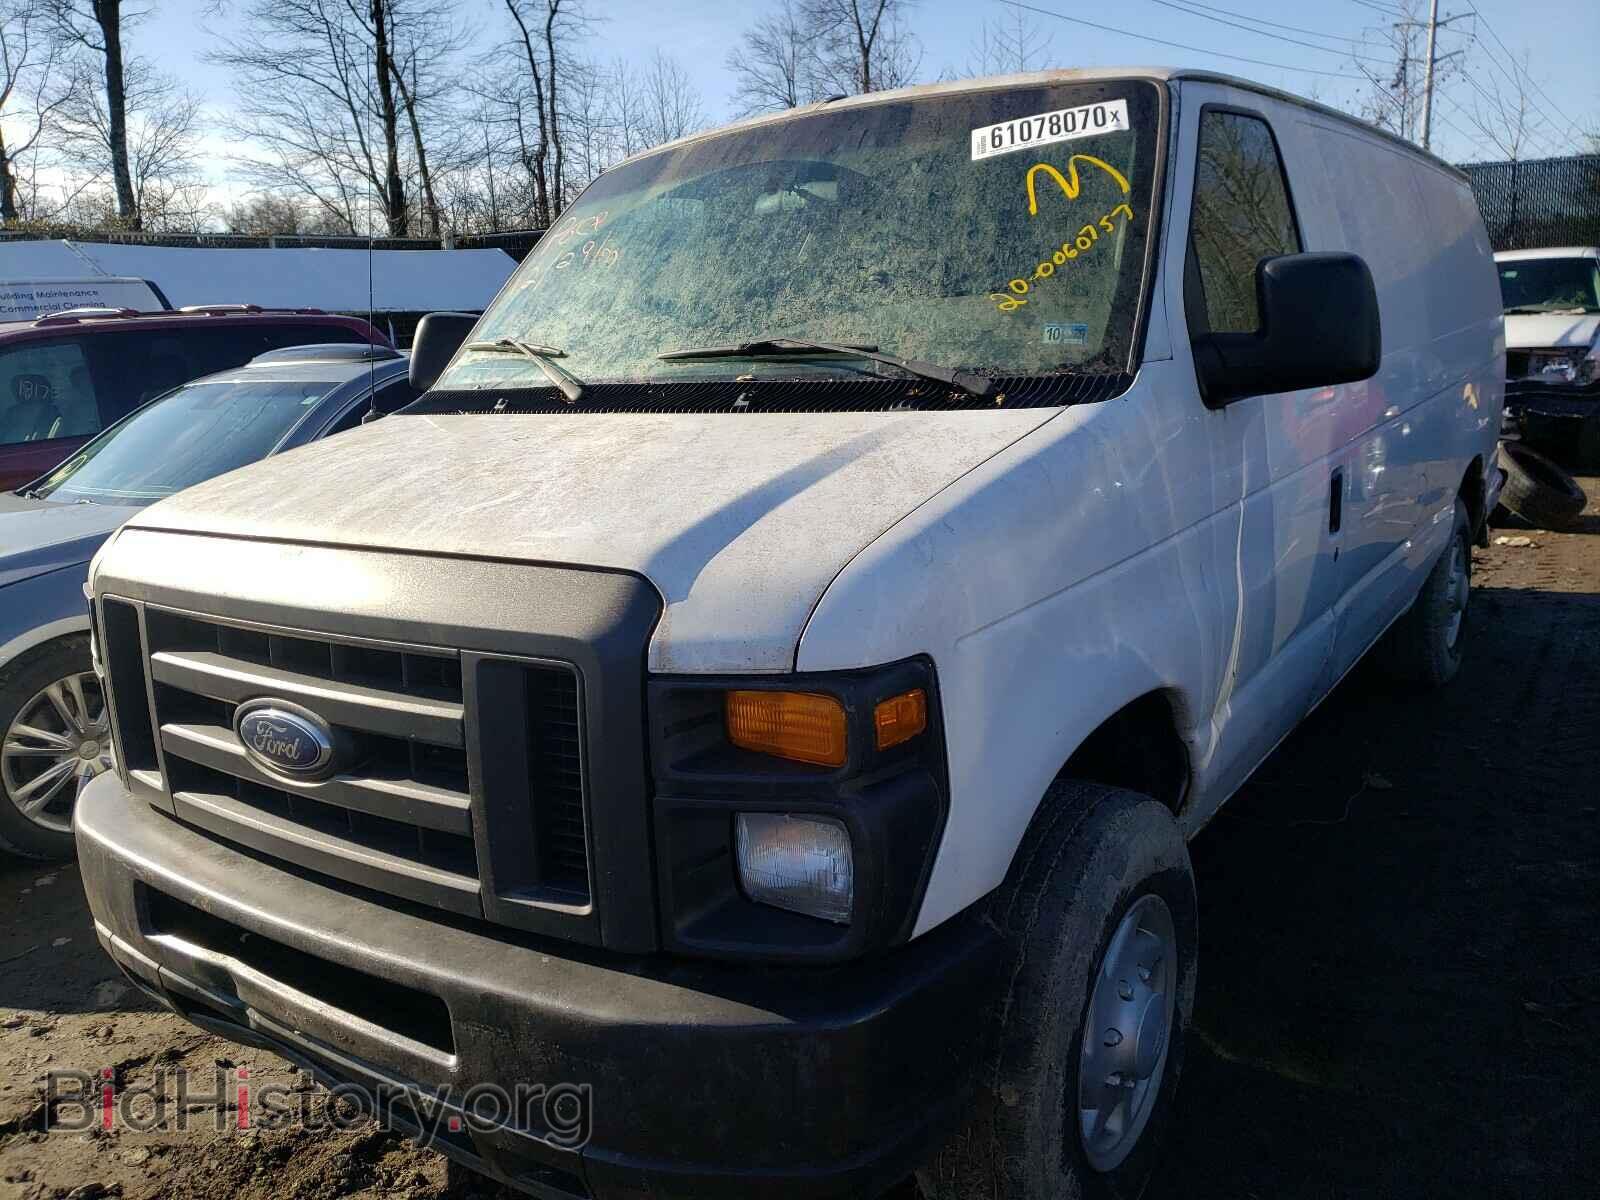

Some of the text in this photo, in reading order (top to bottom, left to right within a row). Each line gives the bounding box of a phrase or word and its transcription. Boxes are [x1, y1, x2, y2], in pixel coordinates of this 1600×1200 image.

[990, 105, 1107, 149] 61078070
[36, 288, 98, 299] Maintenance
[0, 303, 61, 314] Commercial
[254, 720, 300, 760] Ford
